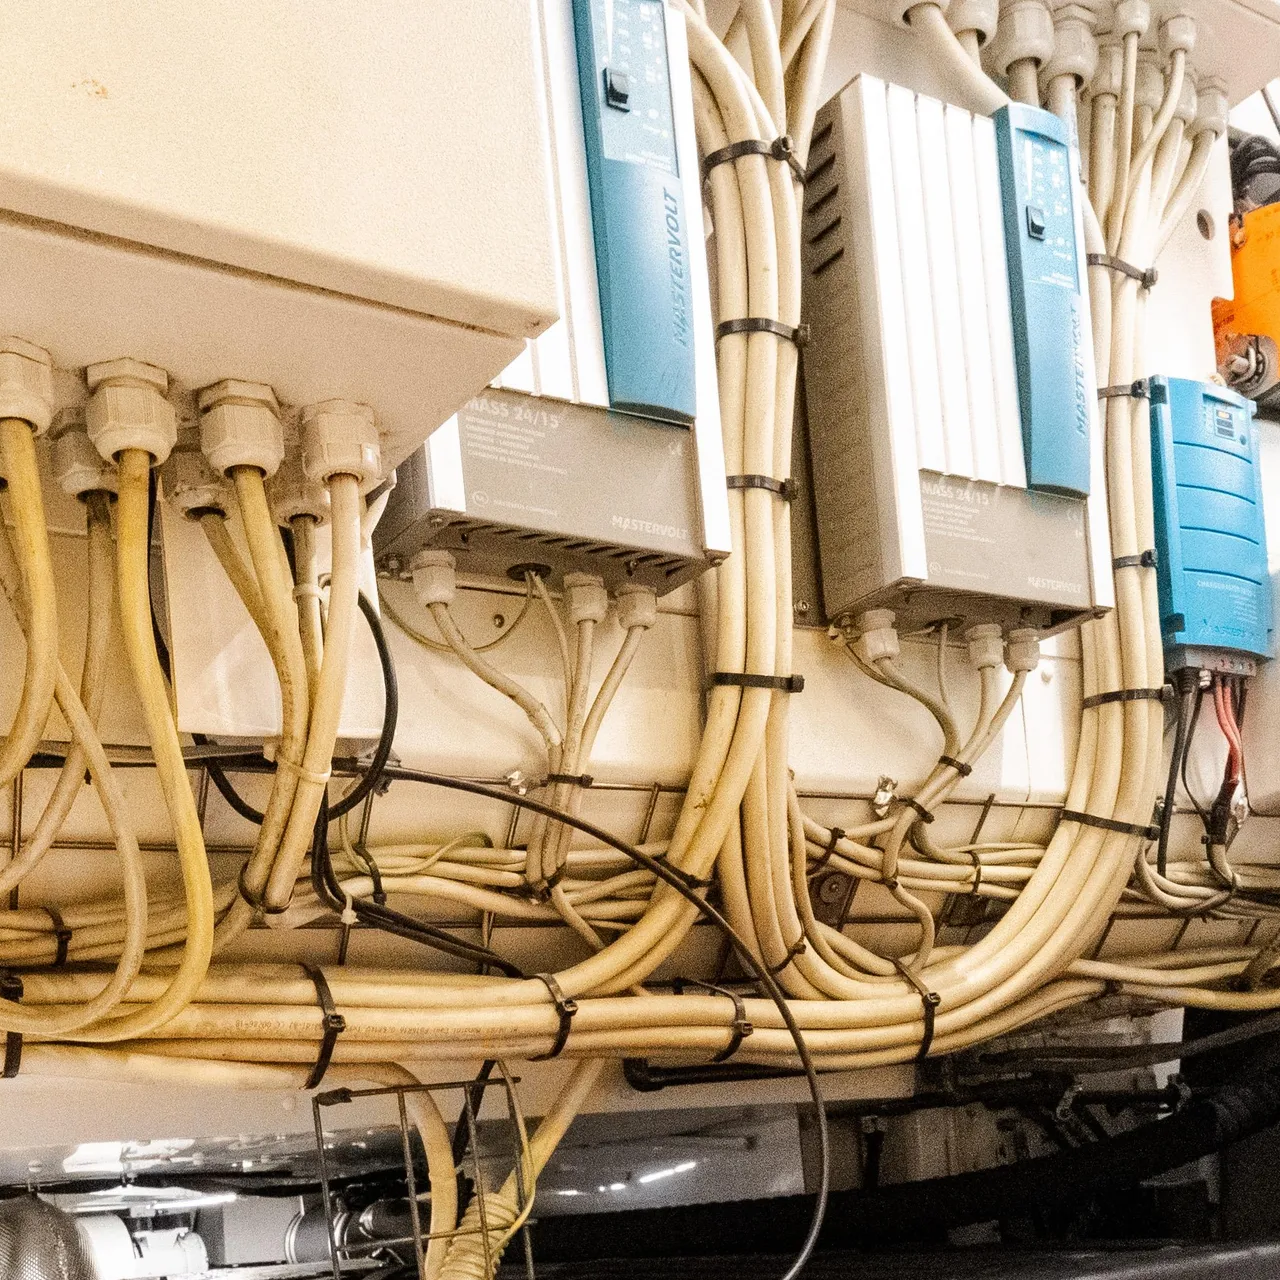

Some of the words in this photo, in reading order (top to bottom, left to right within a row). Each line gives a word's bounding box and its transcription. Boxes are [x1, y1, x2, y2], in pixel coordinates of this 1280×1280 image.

[663, 186, 688, 348] MASTERVOLT
[922, 482, 953, 498] MASS
[611, 515, 688, 540] MASTERVOLT
